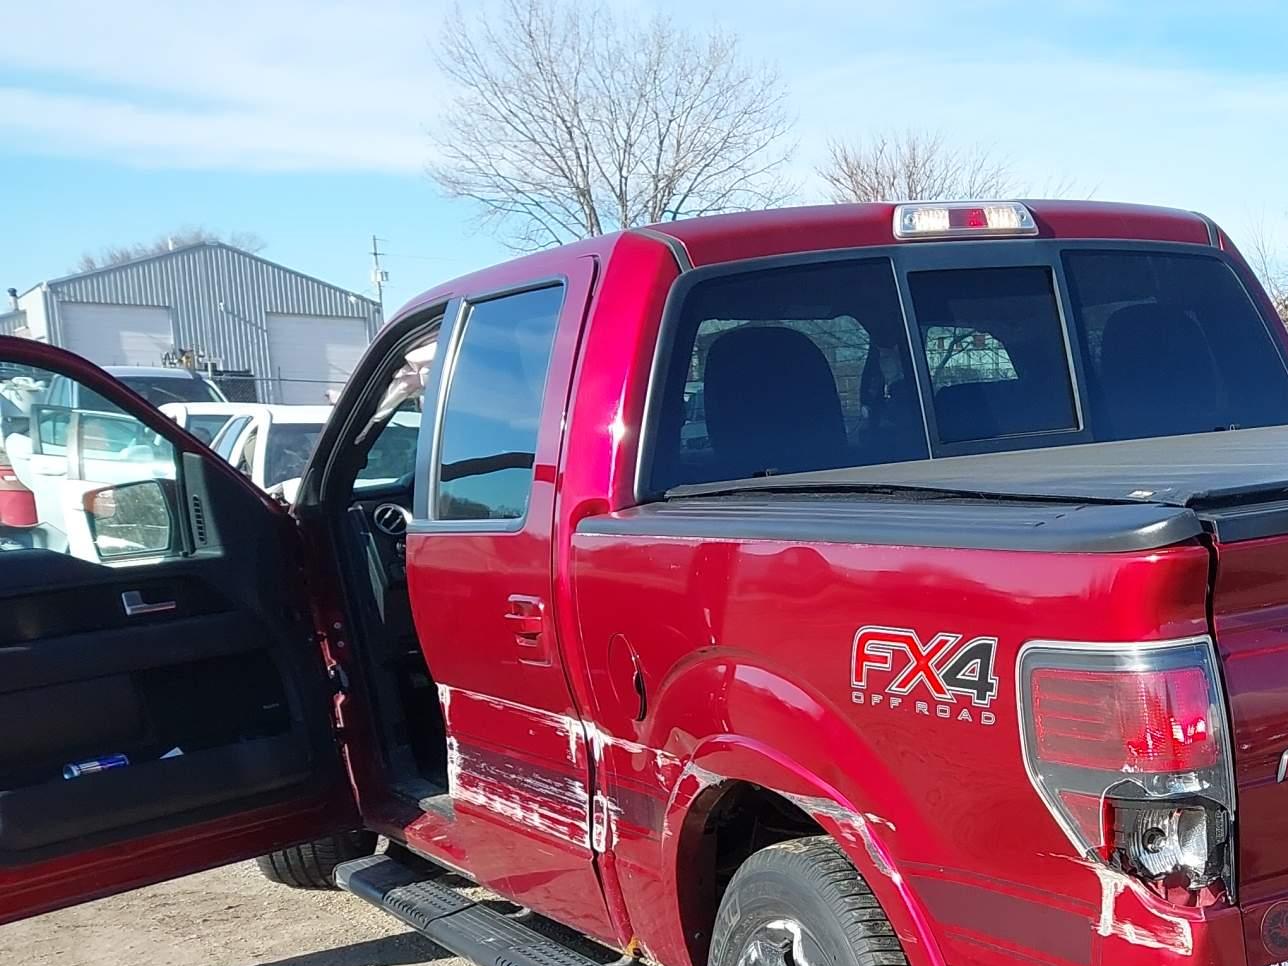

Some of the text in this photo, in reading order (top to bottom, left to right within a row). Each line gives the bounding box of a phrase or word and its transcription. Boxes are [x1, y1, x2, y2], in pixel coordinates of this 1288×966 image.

[851, 625, 999, 708] FX4
[851, 692, 996, 725] OFF ROAD
